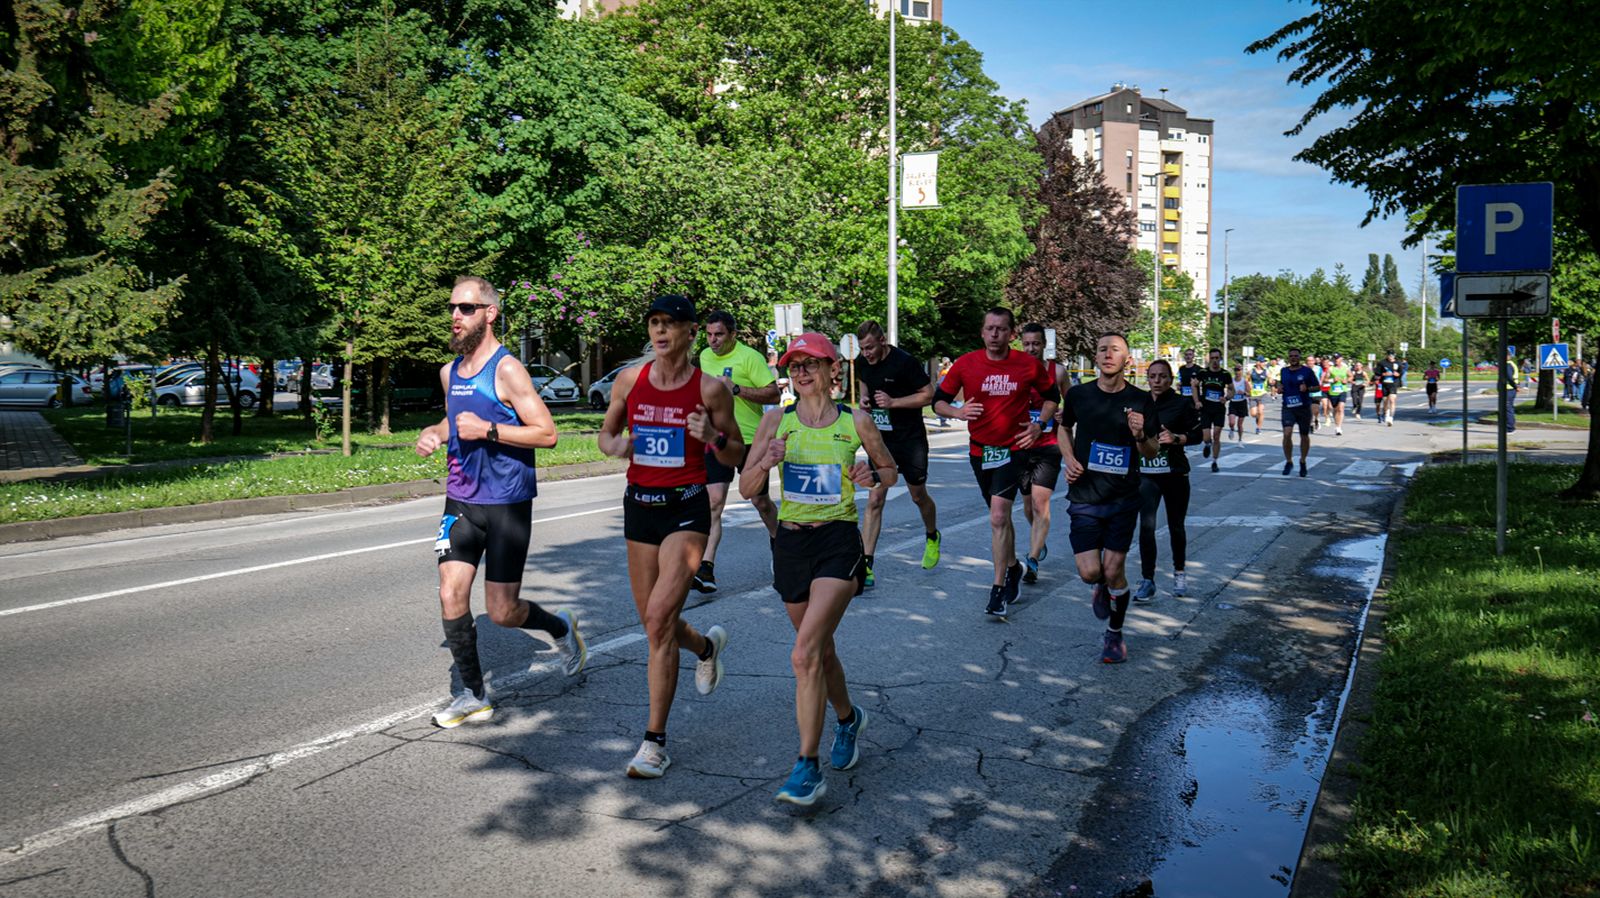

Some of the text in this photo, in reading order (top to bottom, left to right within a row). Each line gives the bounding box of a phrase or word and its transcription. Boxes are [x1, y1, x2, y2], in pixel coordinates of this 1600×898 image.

[1485, 202, 1524, 255] P
[981, 382, 1018, 393] MARATON
[870, 414, 889, 424] 204
[645, 437, 669, 455] 30
[984, 448, 1008, 462] 1257
[1097, 451, 1124, 466] 156
[798, 475, 822, 493] 71
[635, 492, 666, 502] LEKI
